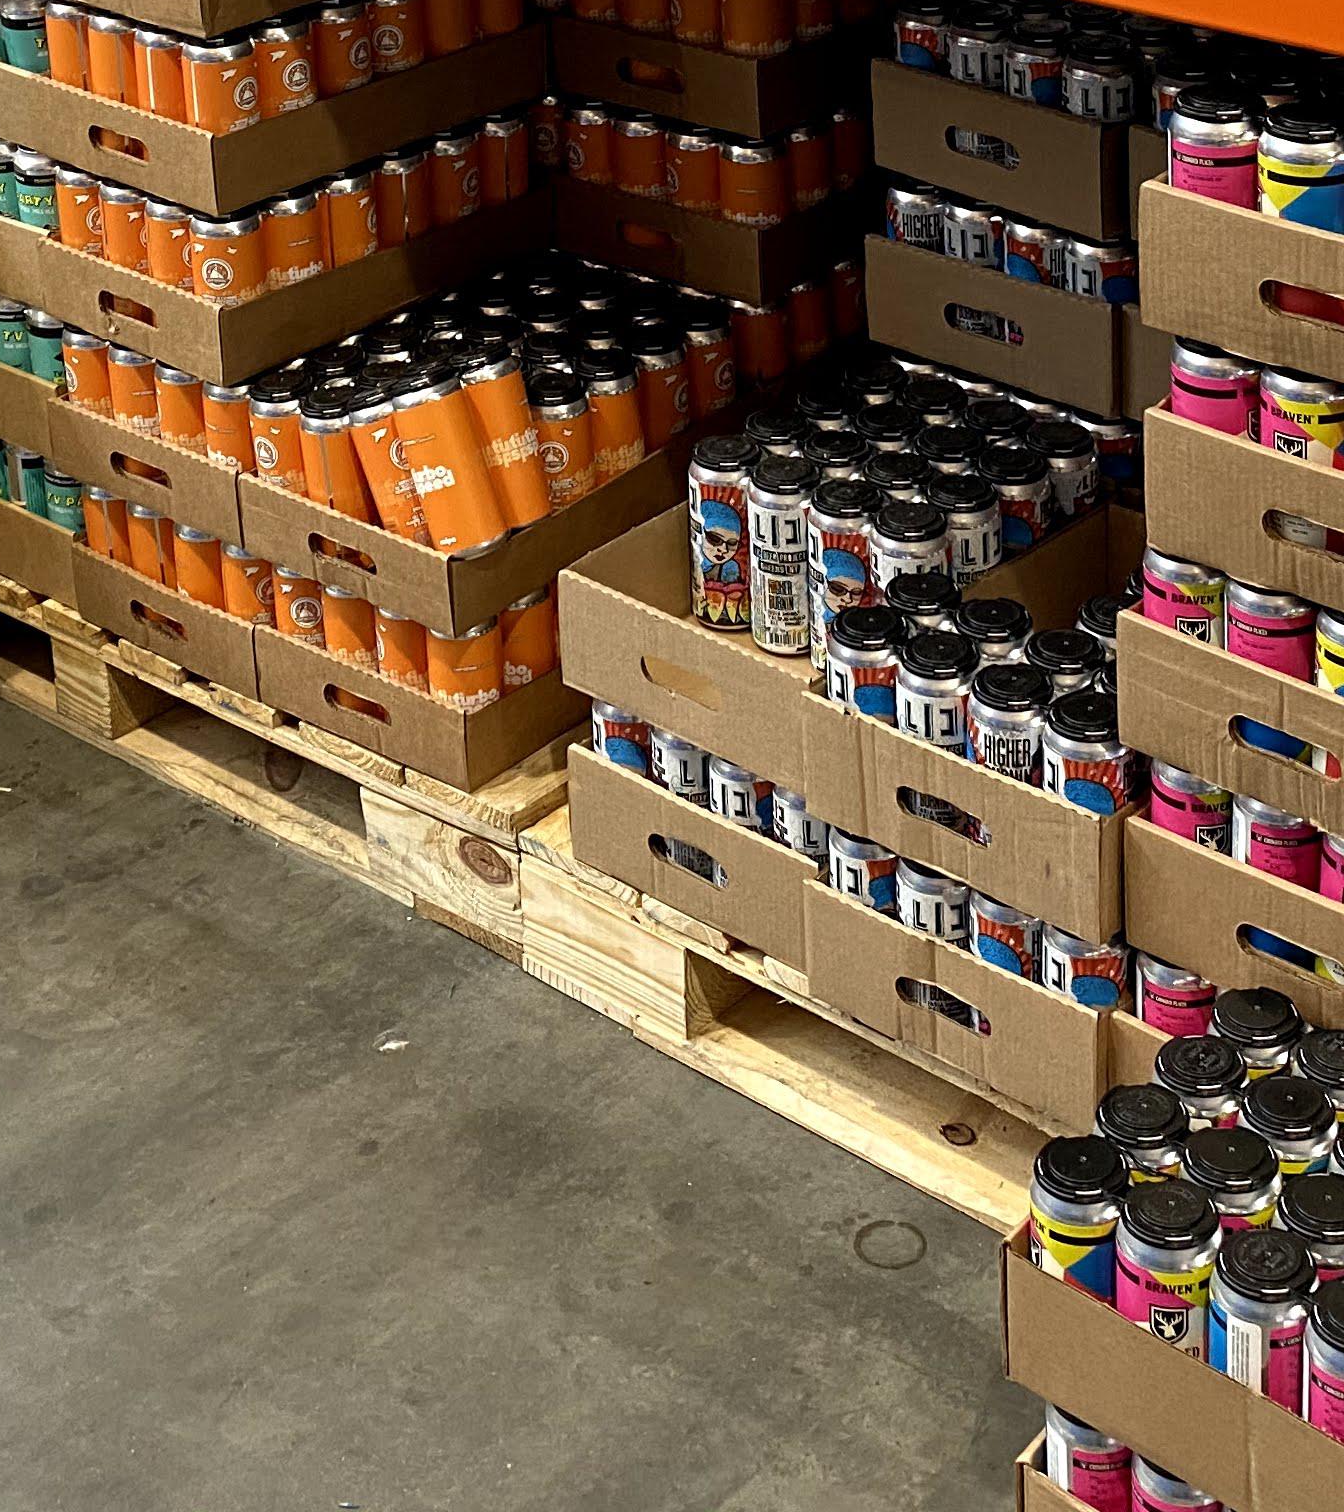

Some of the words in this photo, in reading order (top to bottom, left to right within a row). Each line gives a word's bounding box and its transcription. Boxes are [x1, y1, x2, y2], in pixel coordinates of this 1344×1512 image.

[901, 212, 941, 239] HIGHER
[1272, 407, 1315, 425] BRAVEN
[1171, 593, 1217, 604] BRAVEN
[984, 734, 1031, 767] HIGHER
[1145, 1280, 1193, 1294] BRAVEN
